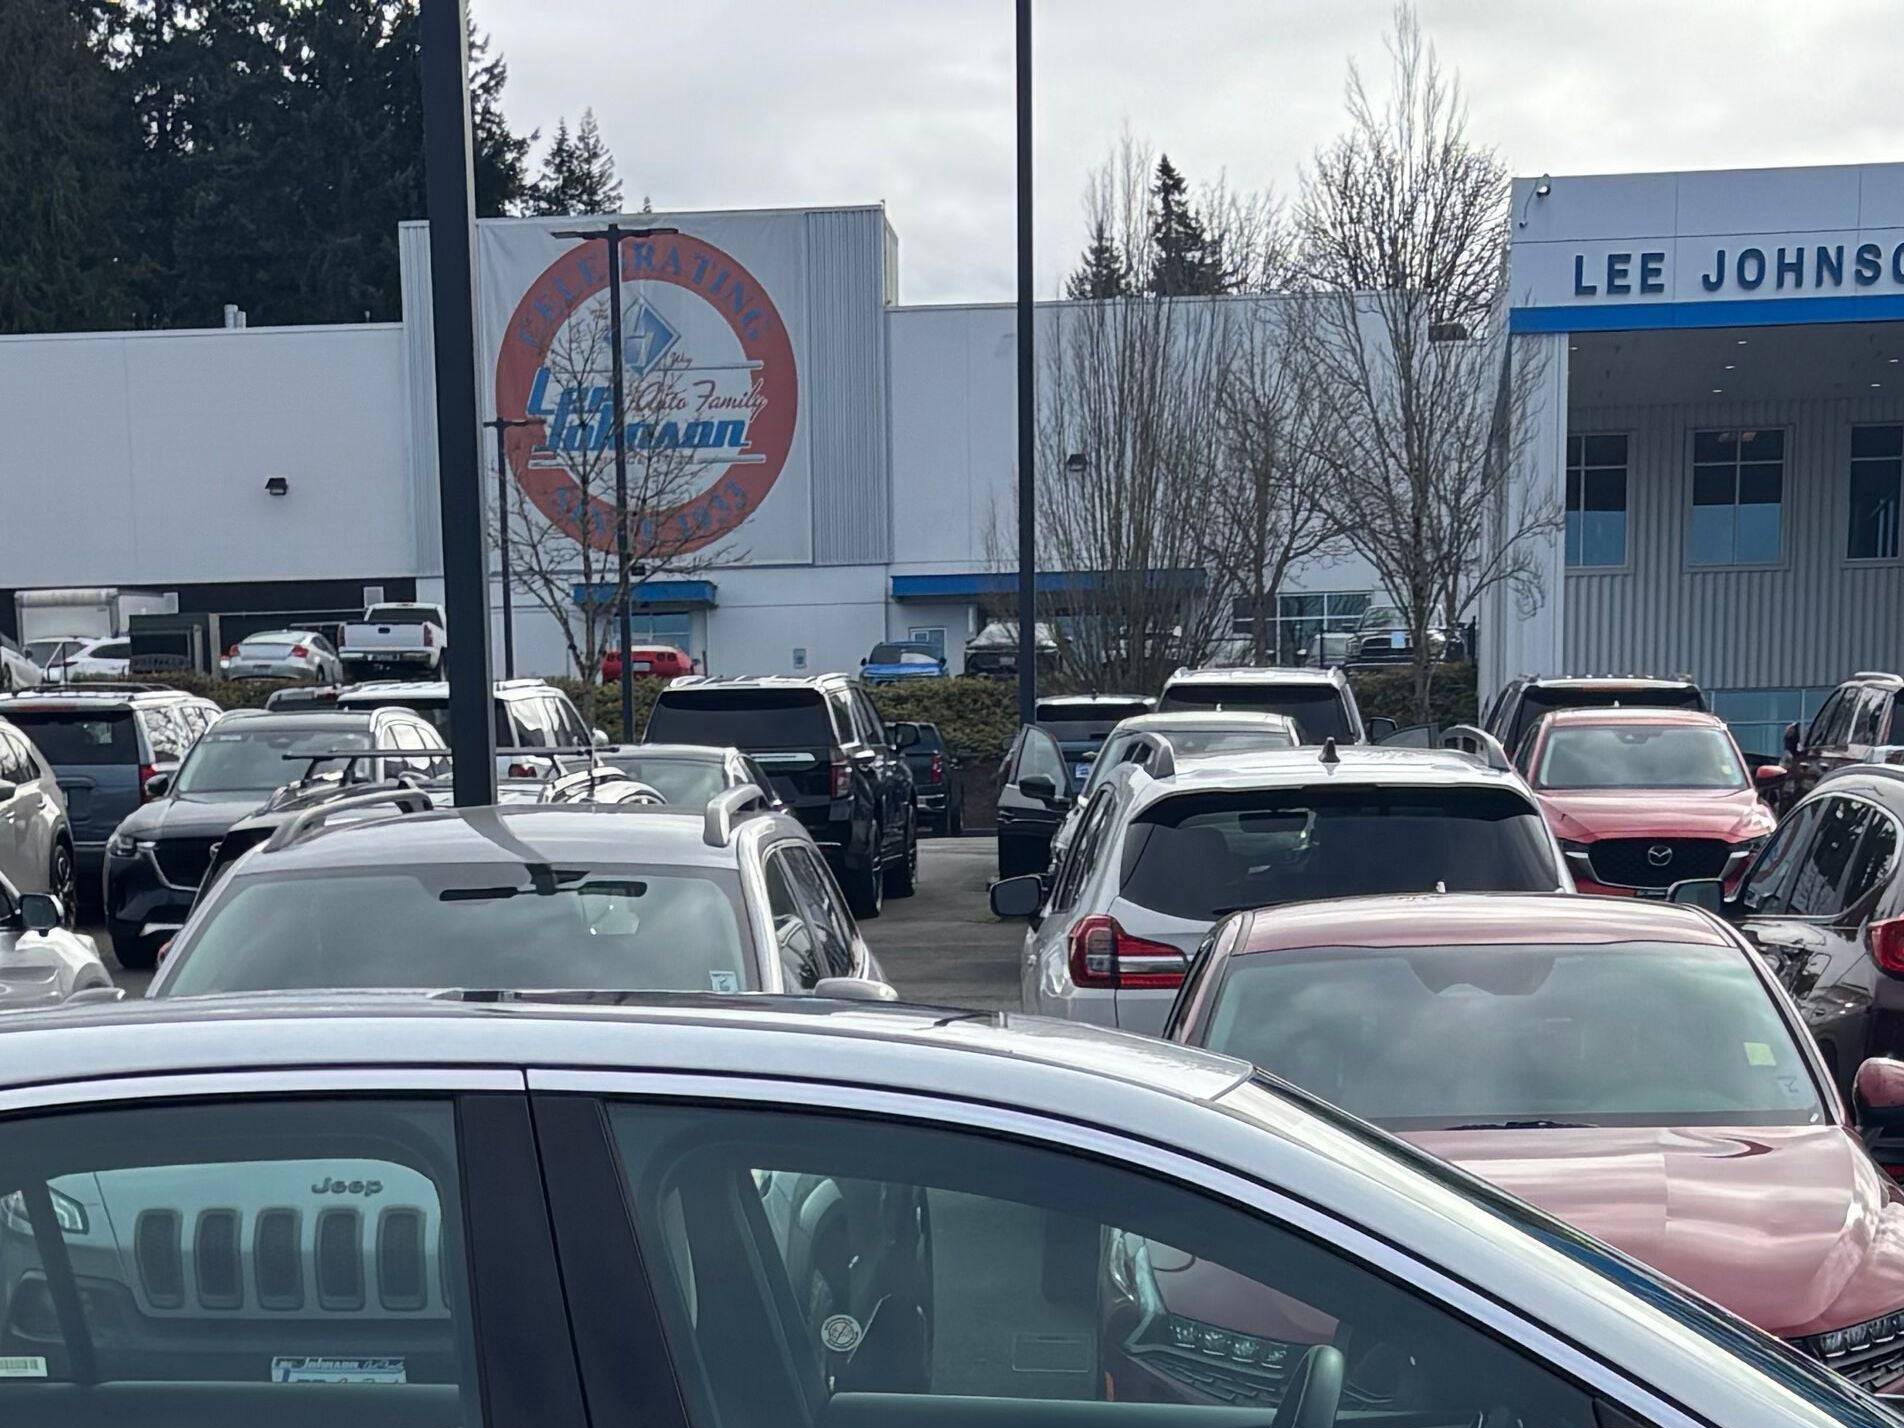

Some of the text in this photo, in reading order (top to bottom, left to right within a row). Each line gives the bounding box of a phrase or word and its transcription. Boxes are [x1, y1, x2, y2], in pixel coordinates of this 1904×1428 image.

[518, 241, 771, 347] CELERATING
[1574, 252, 1666, 296] LEE
[693, 378, 769, 424] Family
[311, 1177, 384, 1197] Jeep
